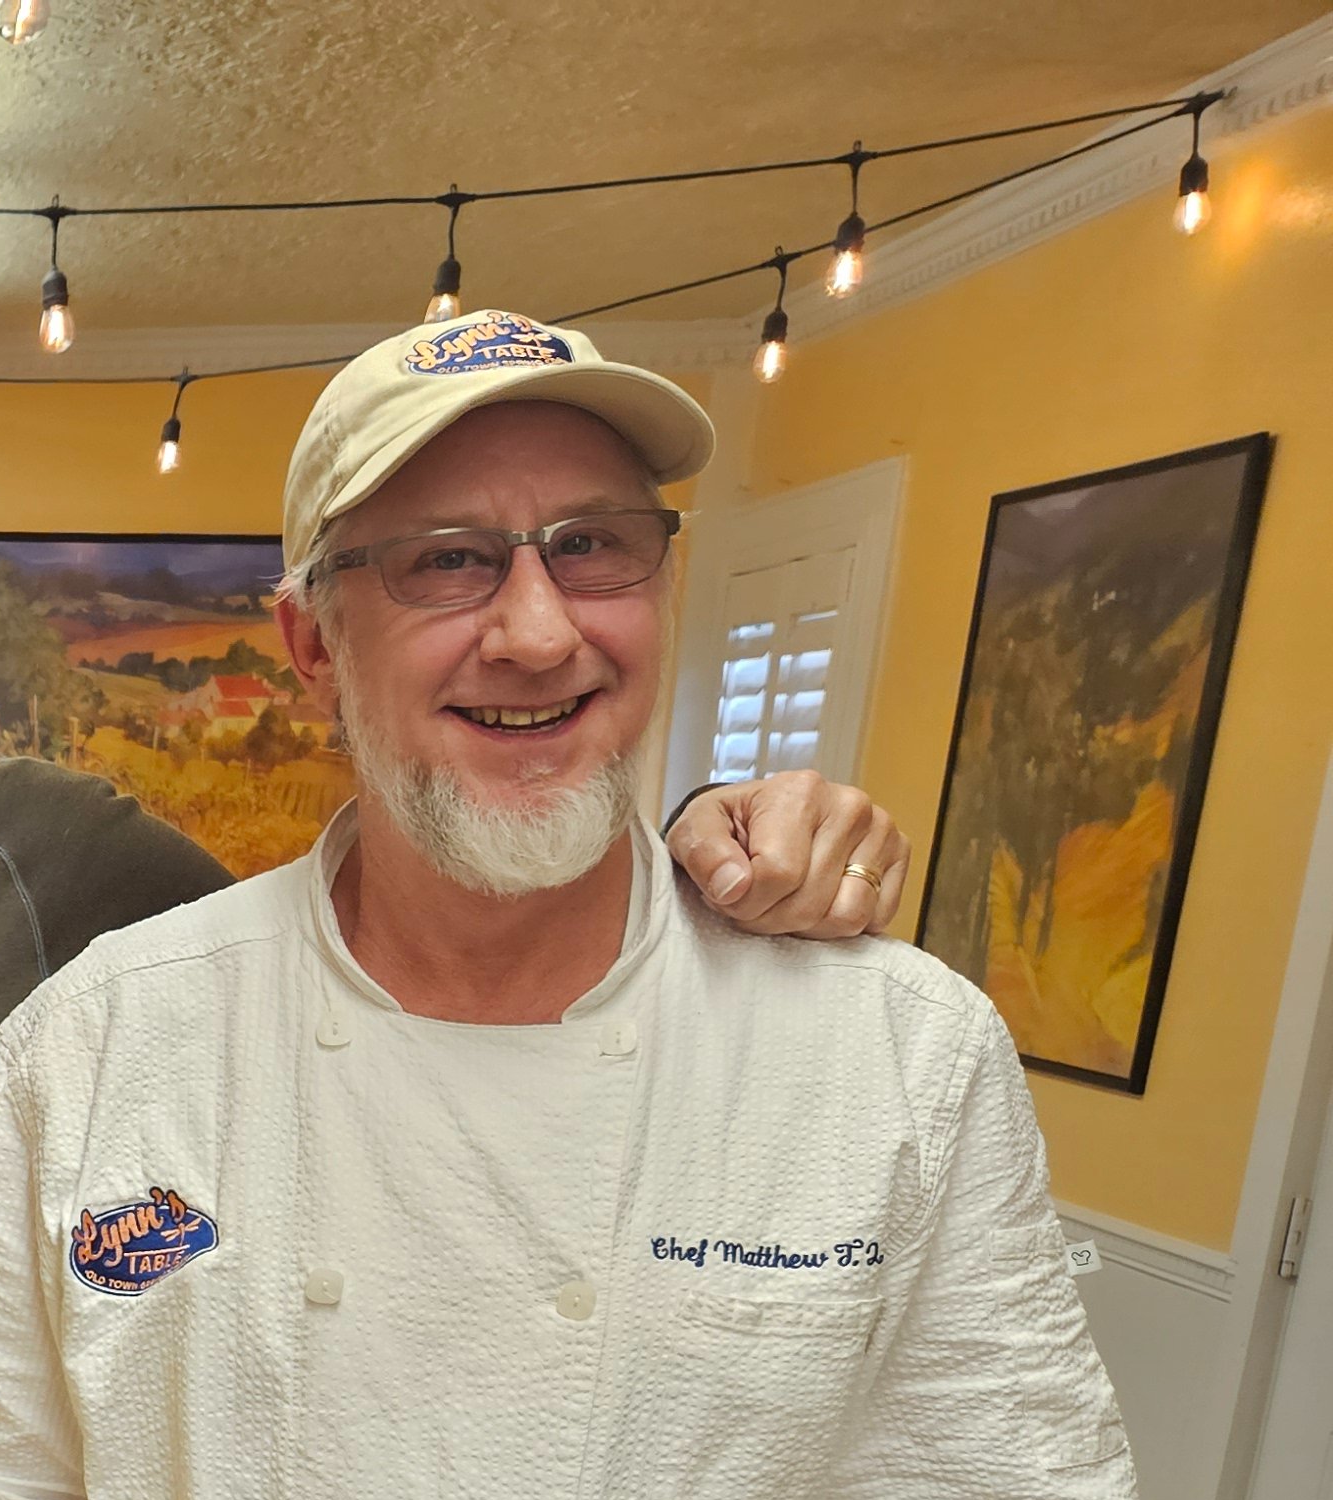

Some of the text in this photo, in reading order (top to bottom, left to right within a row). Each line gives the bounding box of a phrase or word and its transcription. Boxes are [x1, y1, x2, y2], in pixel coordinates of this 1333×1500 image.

[405, 311, 533, 370] Lynn's
[481, 347, 554, 360] TABLE
[437, 366, 460, 374] OLD
[71, 1186, 188, 1267] Lynn's
[128, 1250, 185, 1275] TABLE
[651, 1237, 708, 1268] Chef
[713, 1240, 829, 1269] Matthew
[84, 1270, 138, 1290] OLD TOWN
